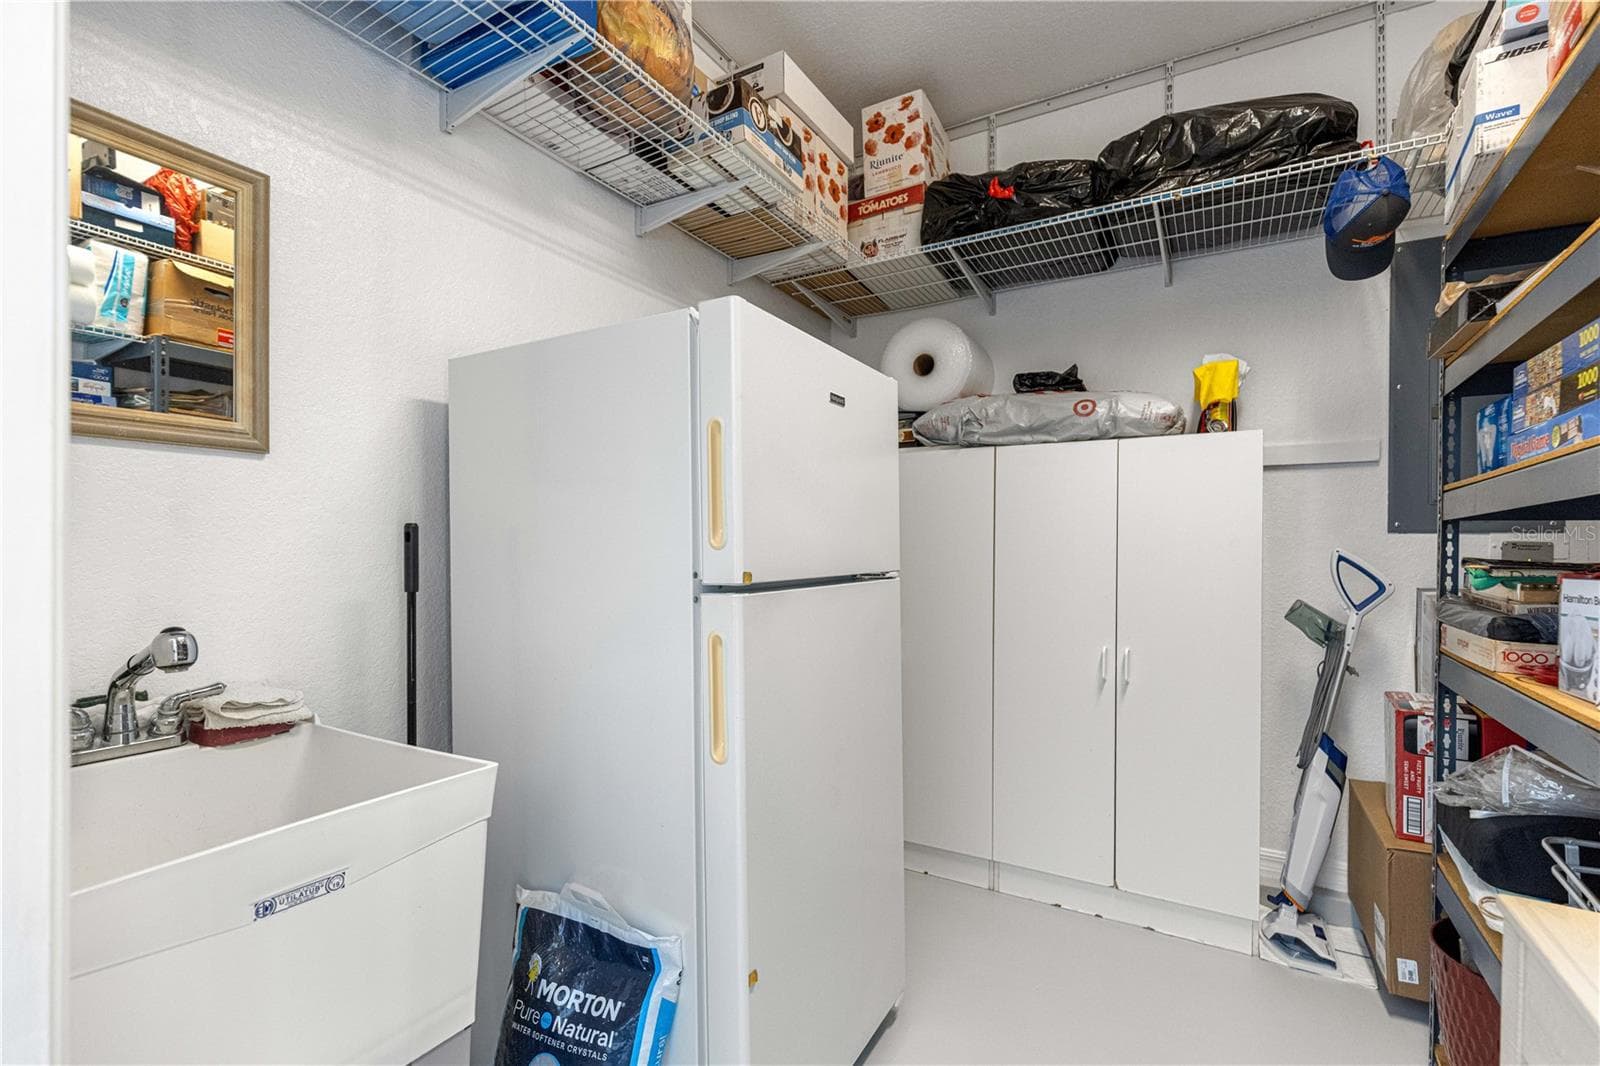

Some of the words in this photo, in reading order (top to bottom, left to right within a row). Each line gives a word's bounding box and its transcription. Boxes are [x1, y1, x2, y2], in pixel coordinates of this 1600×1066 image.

[1485, 40, 1551, 65] BOSE
[1485, 109, 1513, 121] Wave
[870, 153, 904, 169] Riunite
[857, 193, 909, 216] TOMATOES
[1579, 323, 1599, 348] 1000
[1577, 366, 1598, 389] 1000
[1563, 594, 1592, 605] Hamilton
[1502, 650, 1549, 665] 1000
[536, 978, 623, 1022] MORTON
[512, 1000, 540, 1025] Pure
[511, 1023, 532, 1035] WATER
[531, 1029, 566, 1050] SOFTENER
[566, 1043, 608, 1062] CRYSTALS
[551, 1016, 614, 1048] Natural
